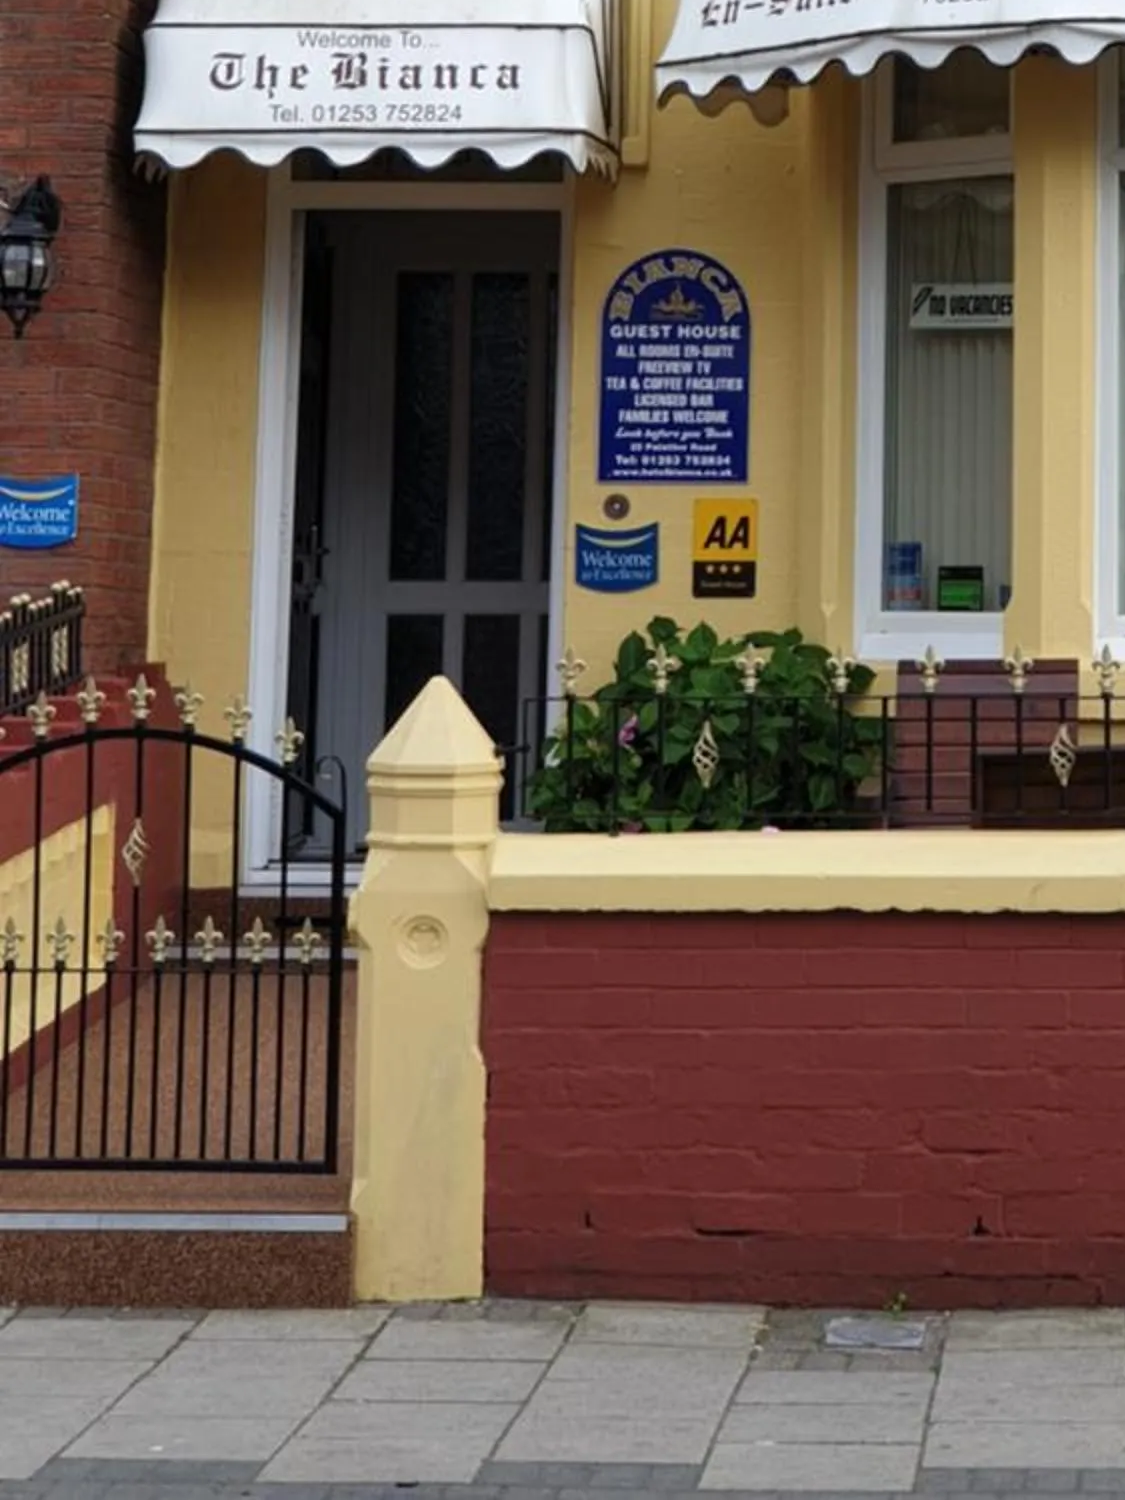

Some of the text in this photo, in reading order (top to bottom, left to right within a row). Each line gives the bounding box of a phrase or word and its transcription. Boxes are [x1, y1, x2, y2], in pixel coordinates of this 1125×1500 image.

[297, 31, 392, 48] Welcome
[209, 51, 520, 99] The Bianca
[268, 104, 463, 123] Tel. 01253 752824
[609, 256, 743, 322] BIANCA
[929, 294, 1014, 316] NO VACANCIES
[609, 324, 742, 339] GUEST HOUSE
[615, 344, 636, 358] ALL
[697, 361, 711, 374] TV
[606, 377, 744, 391] TEA & COFFEE FACILITIES
[672, 409, 729, 424] WELCOME
[703, 515, 750, 549] AA
[581, 550, 653, 568] Welcome
